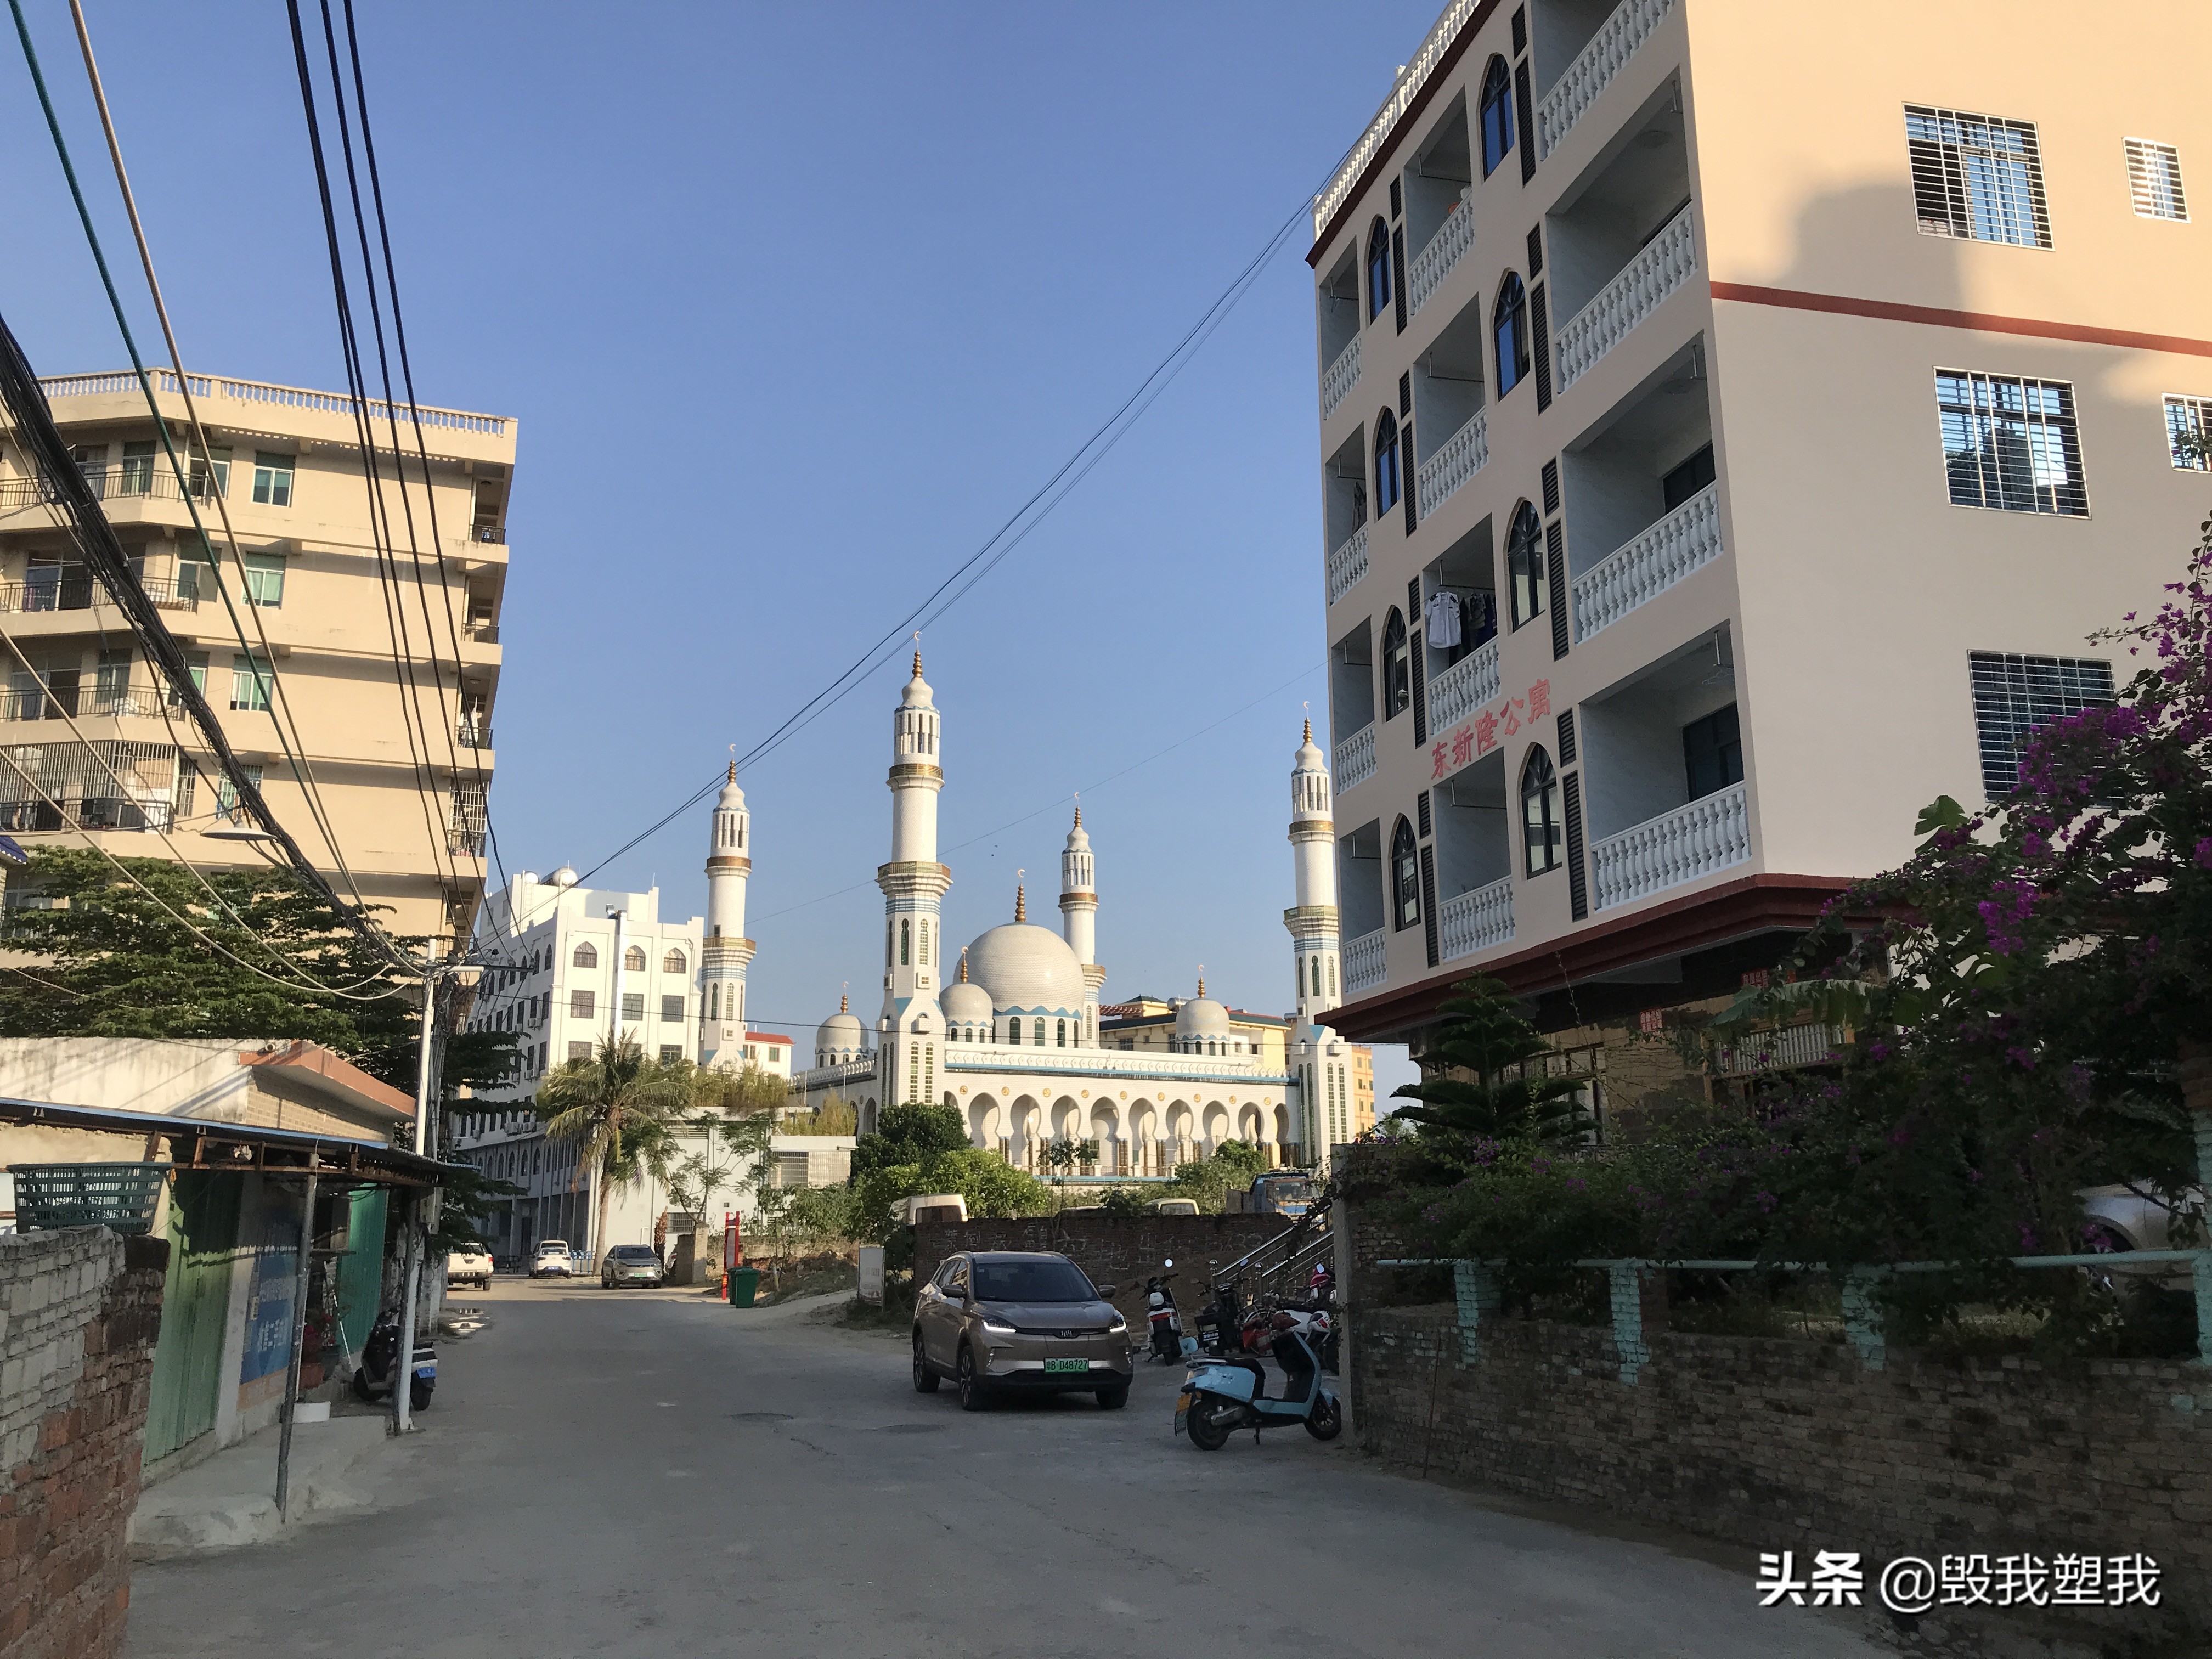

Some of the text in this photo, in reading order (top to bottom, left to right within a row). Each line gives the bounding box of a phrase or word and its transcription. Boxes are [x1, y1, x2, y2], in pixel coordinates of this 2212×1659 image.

[1431, 678, 1551, 780] 东新隆公寓
